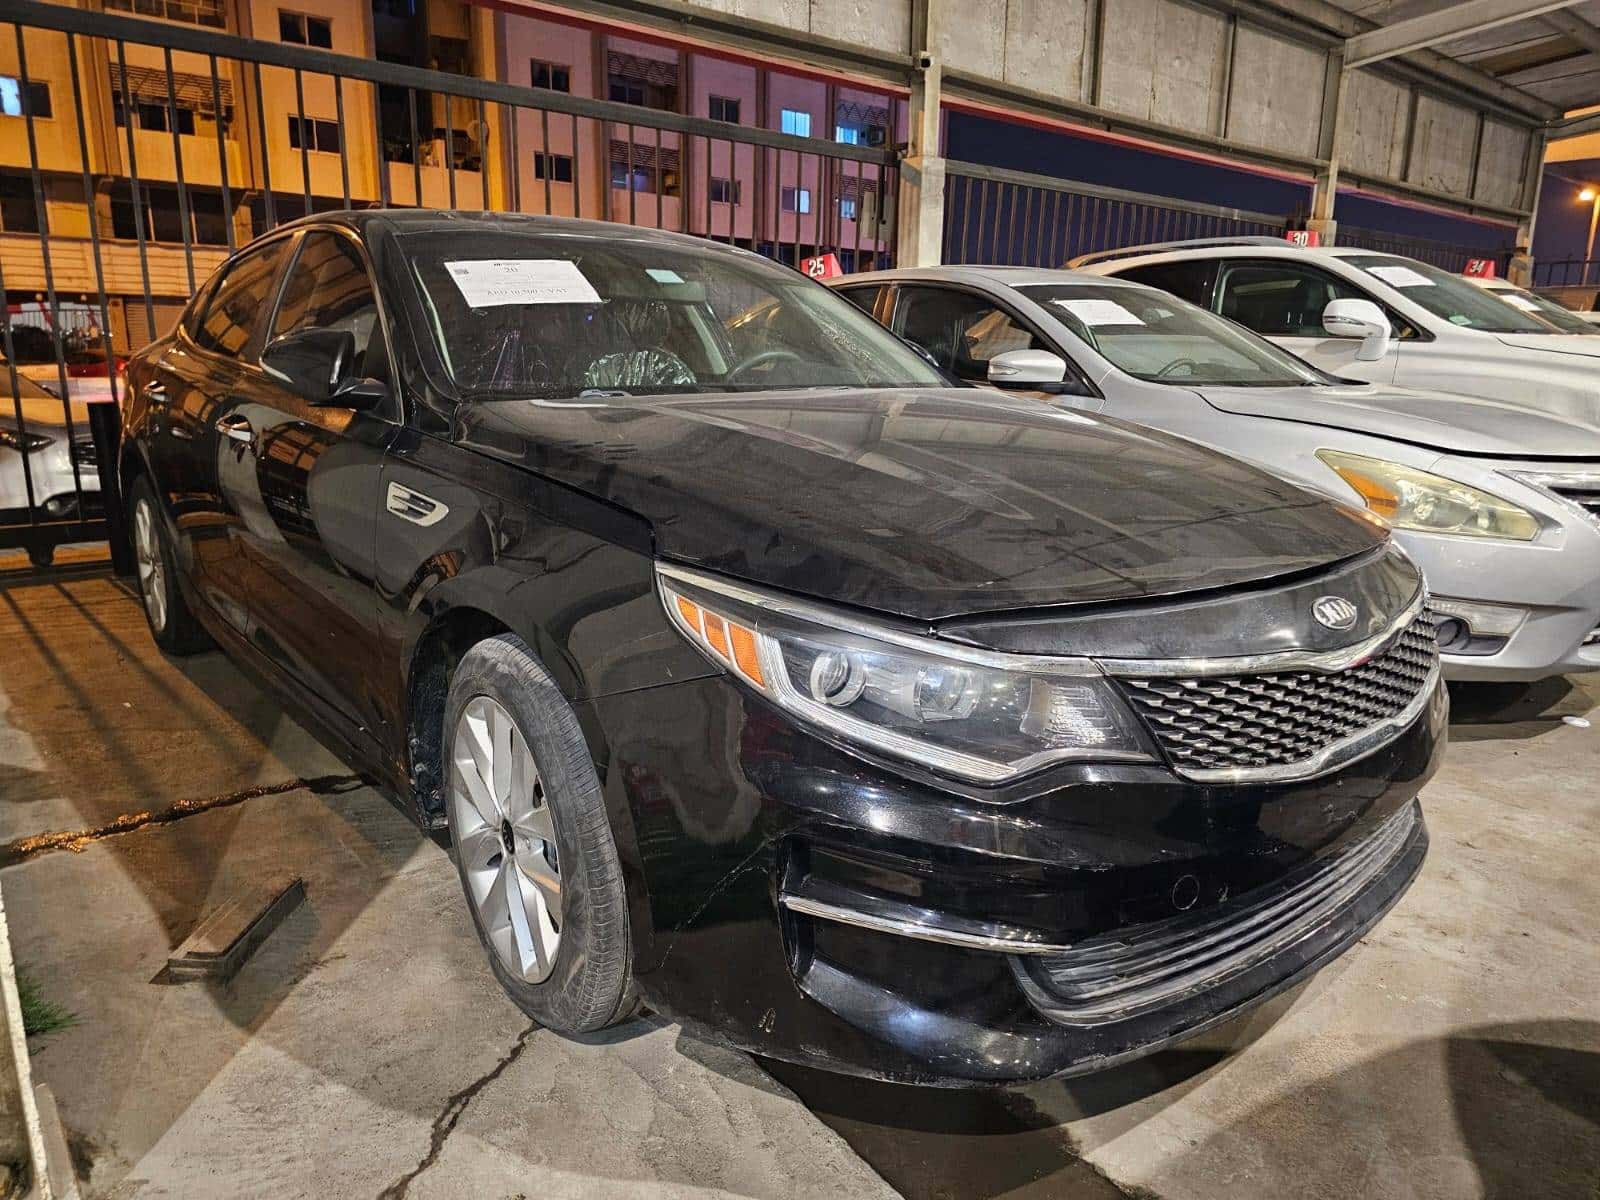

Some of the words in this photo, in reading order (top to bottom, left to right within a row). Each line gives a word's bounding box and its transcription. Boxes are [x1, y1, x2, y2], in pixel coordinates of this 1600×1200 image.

[1293, 231, 1309, 246] 30
[809, 257, 825, 277] 25
[1470, 260, 1486, 272] 34
[1318, 599, 1355, 624] KIA
